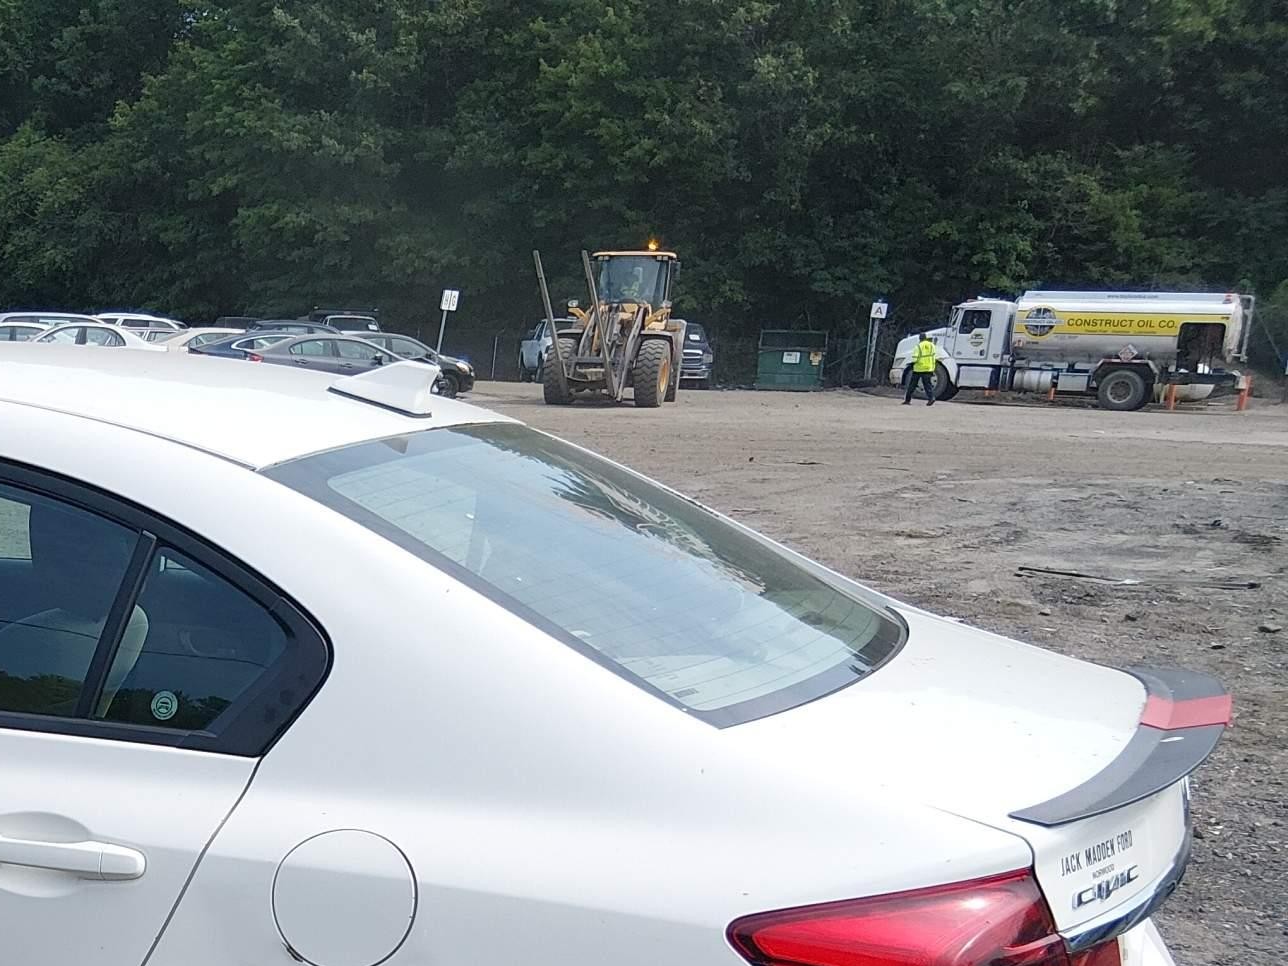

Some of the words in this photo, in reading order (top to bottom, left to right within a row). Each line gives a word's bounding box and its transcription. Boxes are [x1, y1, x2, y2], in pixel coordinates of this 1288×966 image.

[1067, 318, 1134, 328] CONSTRUCT
[1137, 319, 1155, 328] OIL
[1158, 319, 1177, 329] CO.
[1061, 851, 1083, 877] JACK
[1084, 838, 1116, 868] MADDEN
[1116, 829, 1133, 853] FORD
[1072, 864, 1139, 909] CIVIC
